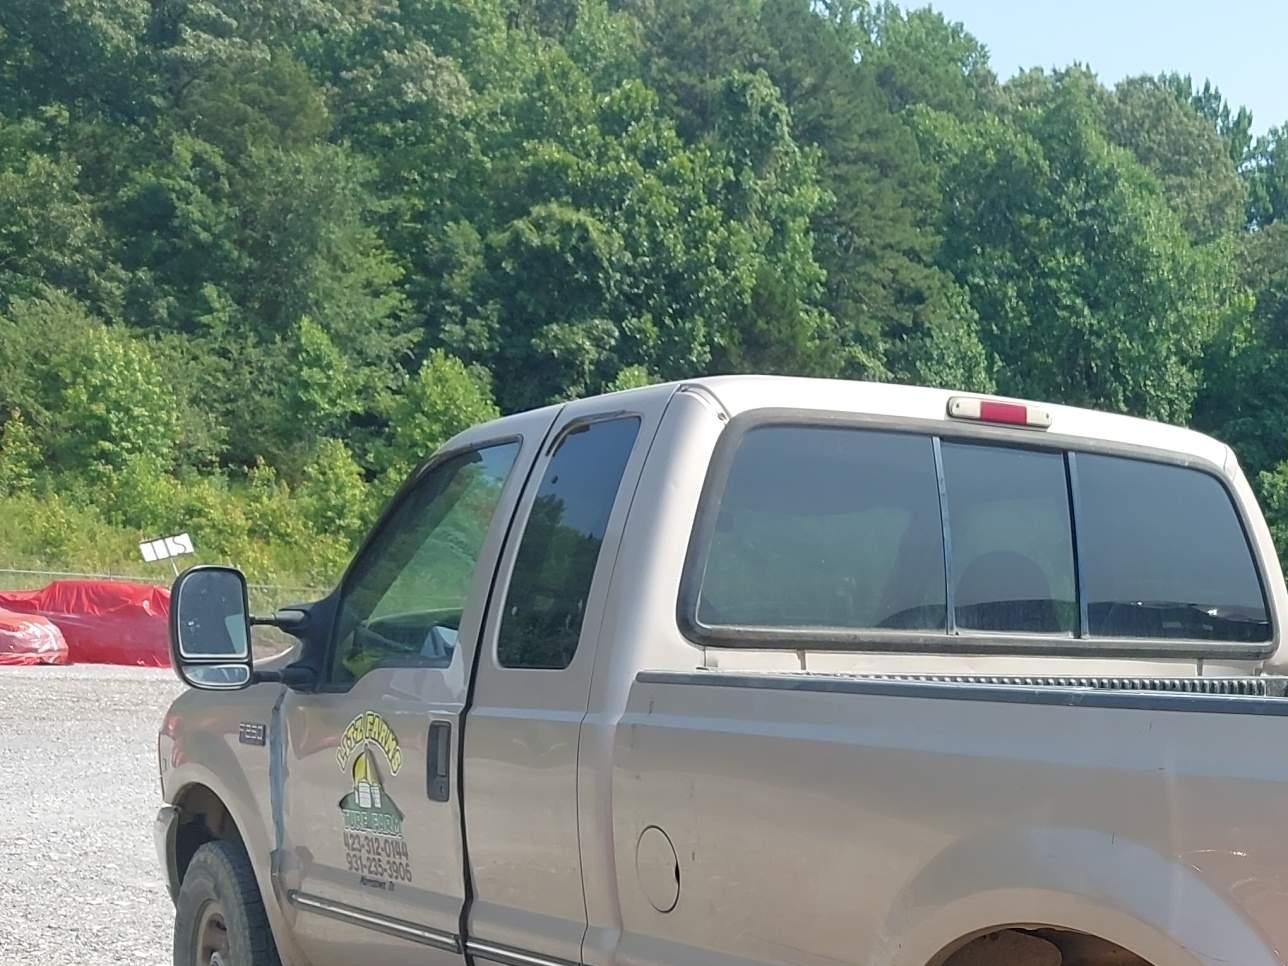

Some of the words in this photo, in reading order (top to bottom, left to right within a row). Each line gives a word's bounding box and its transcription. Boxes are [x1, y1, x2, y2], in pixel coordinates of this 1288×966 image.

[365, 711, 400, 776] FARMS
[343, 832, 408, 860] 423-312-0144
[346, 852, 412, 882] 931-235-3906
